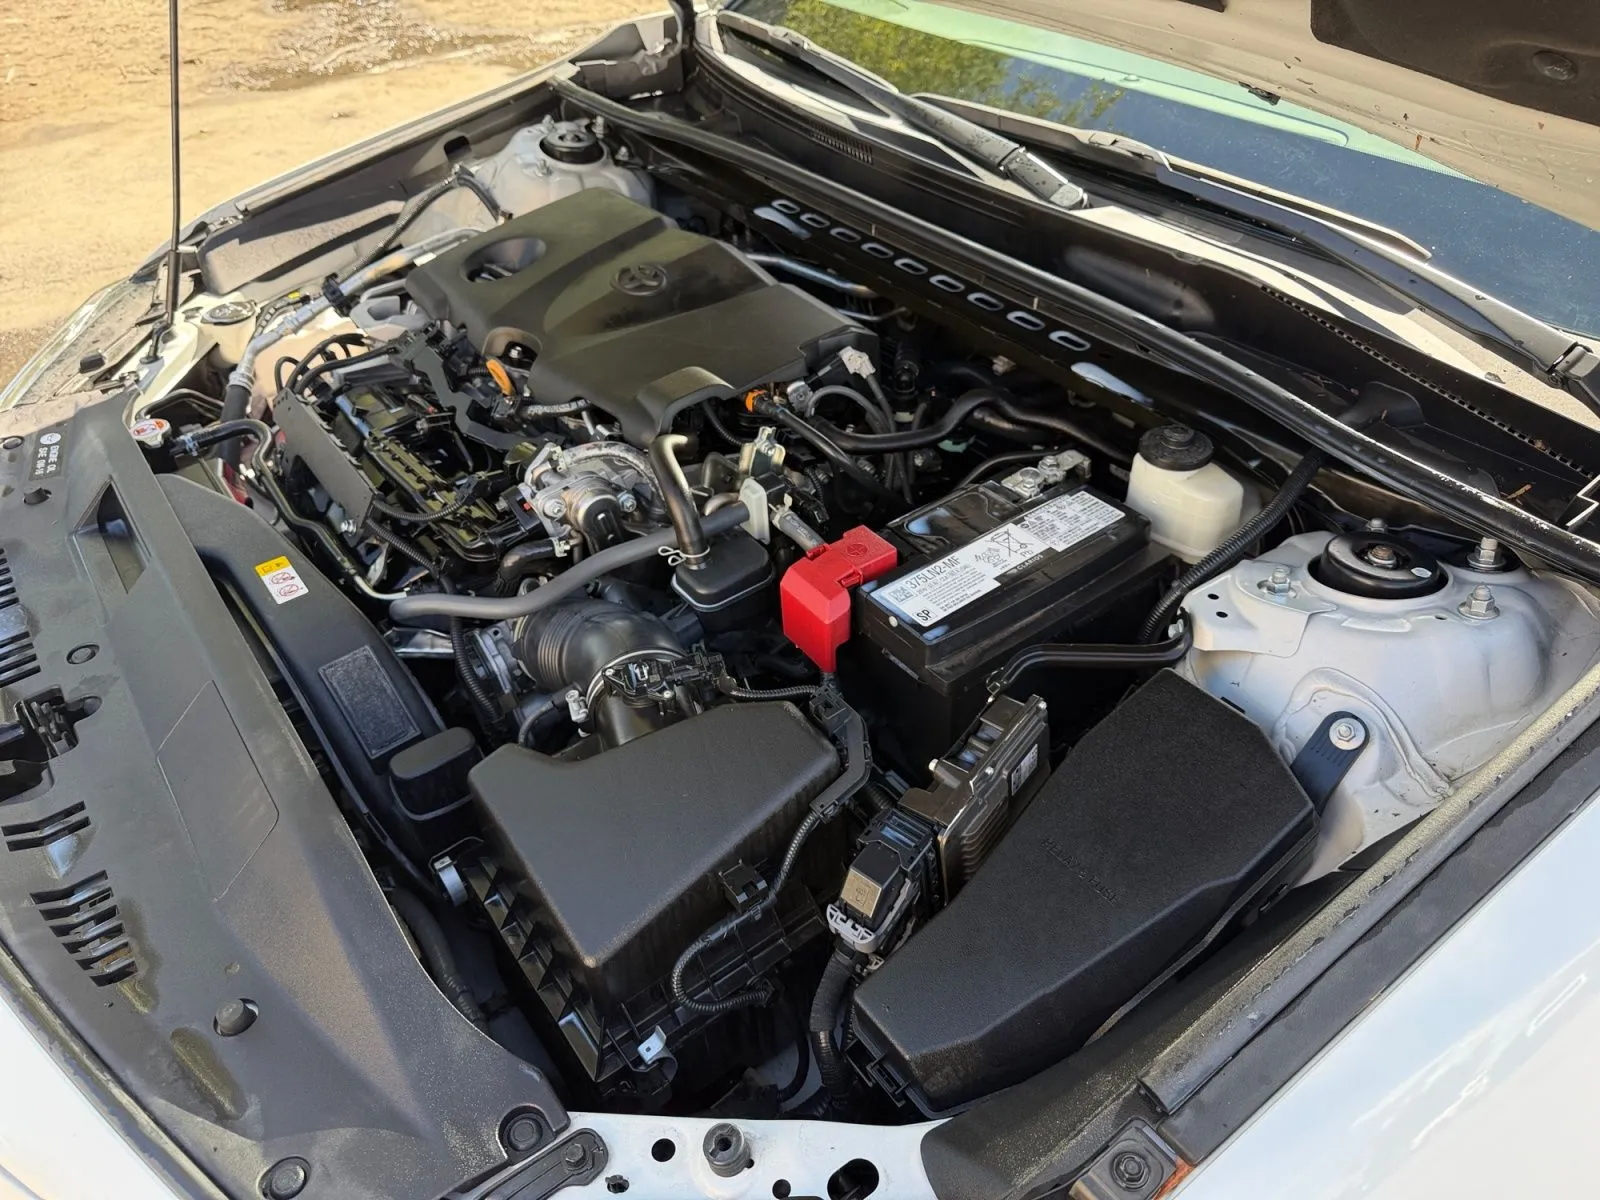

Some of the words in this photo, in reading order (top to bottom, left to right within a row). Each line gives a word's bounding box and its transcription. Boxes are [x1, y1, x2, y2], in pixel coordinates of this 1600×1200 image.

[1019, 548, 1034, 558] Pb
[1016, 553, 1044, 571] CLARIOS
[905, 554, 961, 589] 375LN2-MF
[916, 609, 931, 621] SP
